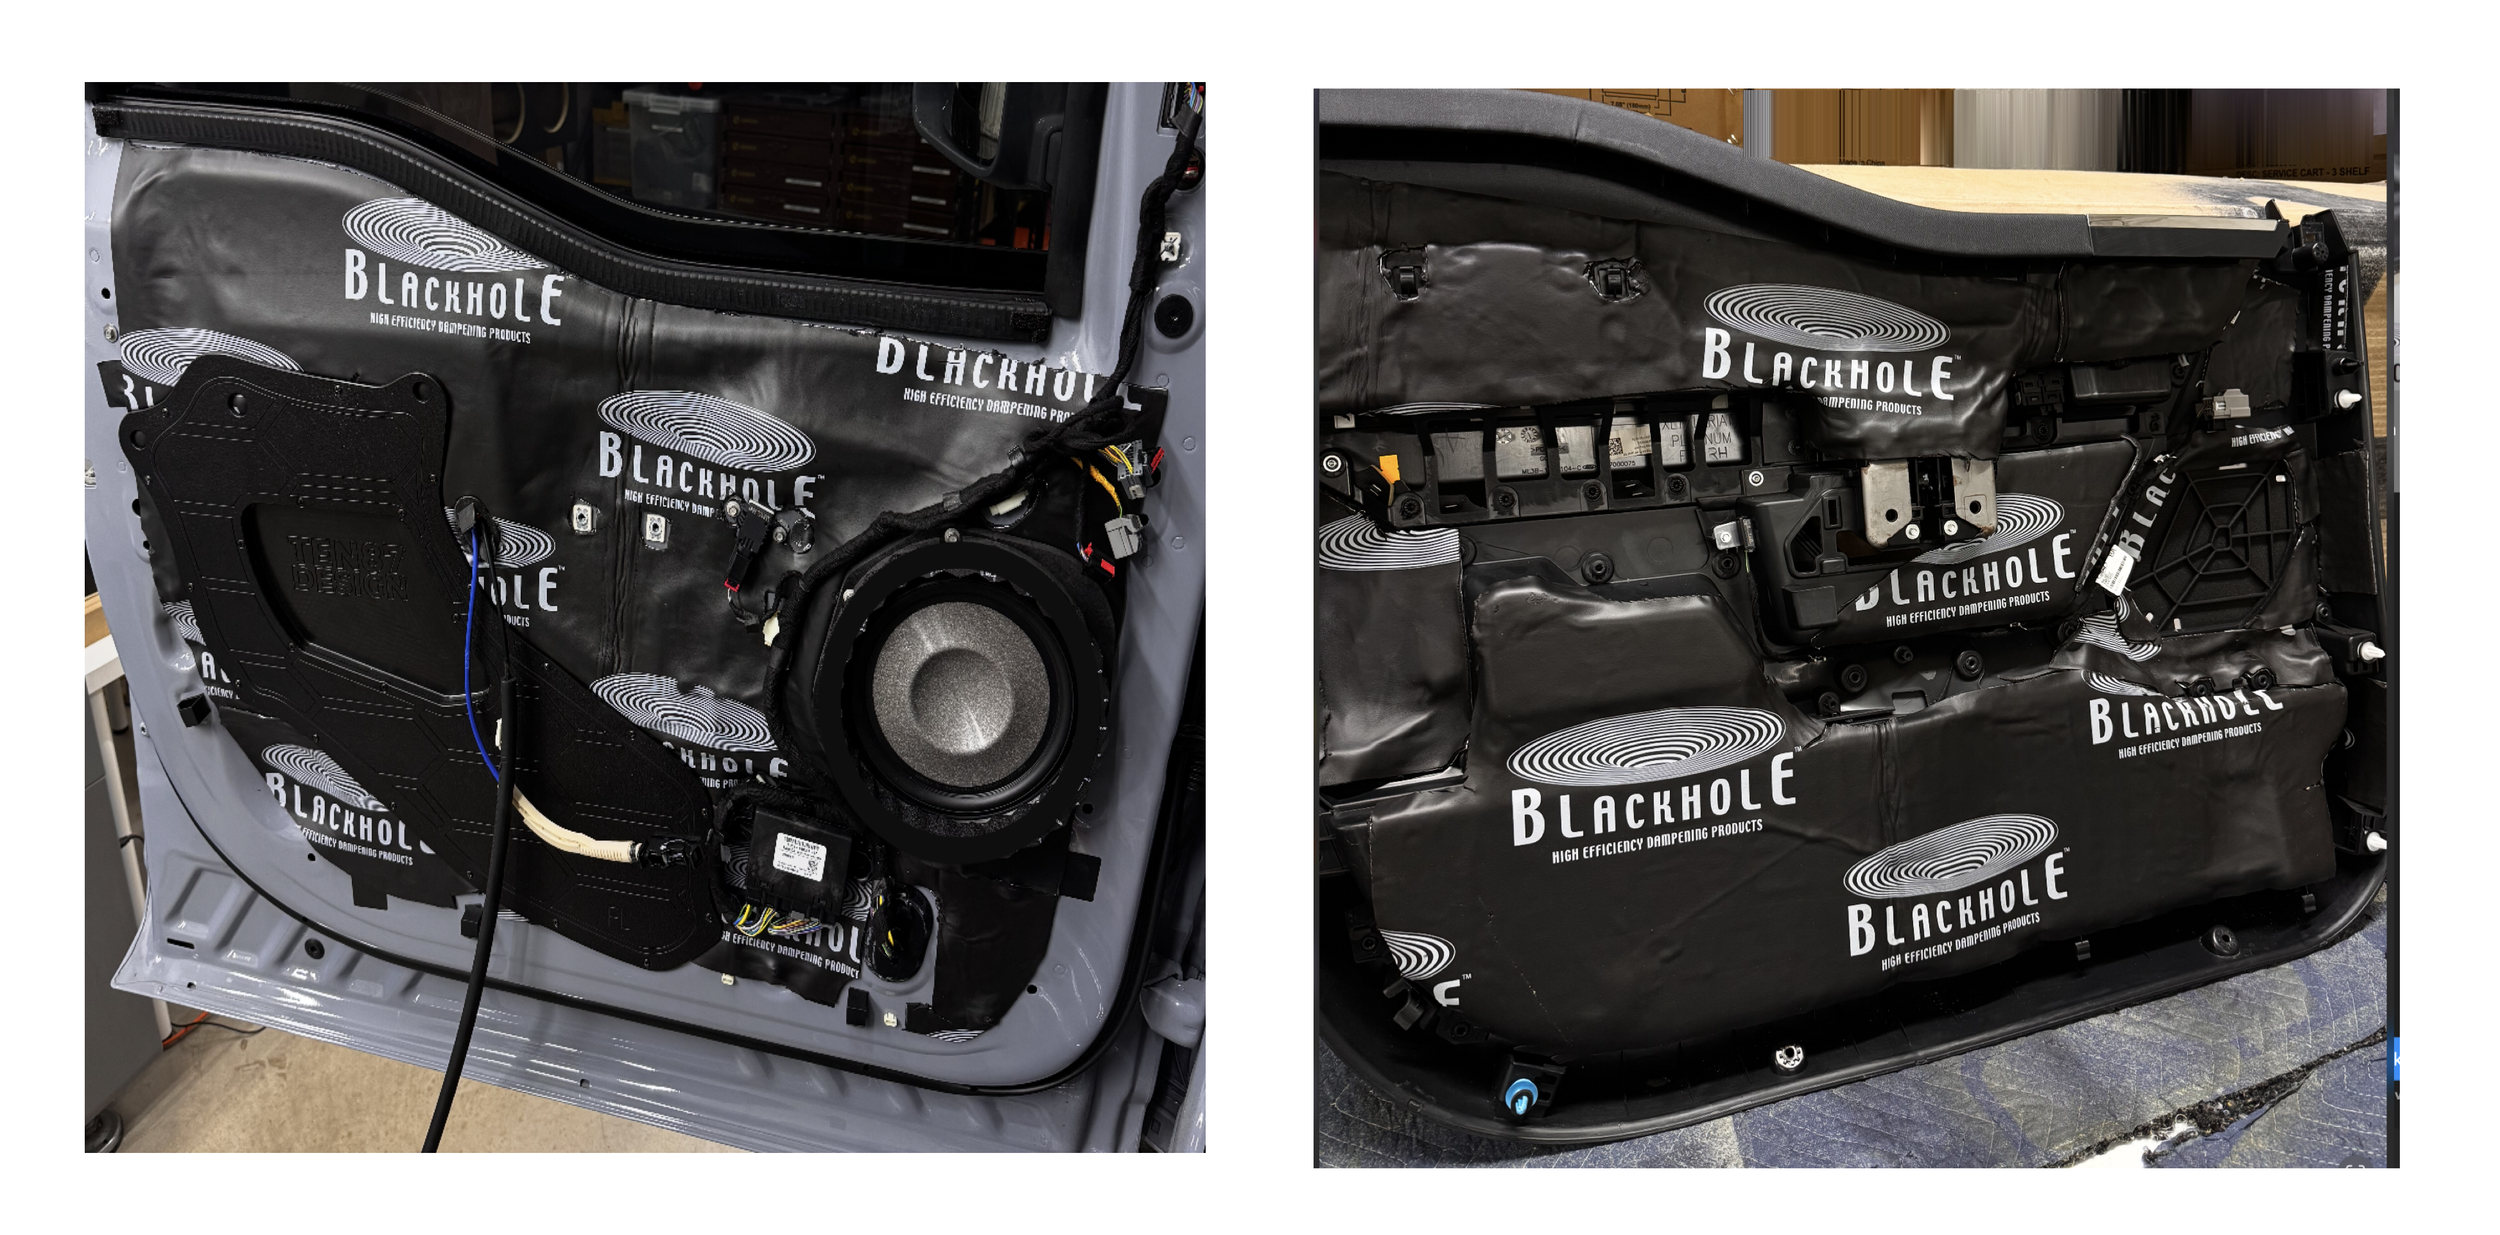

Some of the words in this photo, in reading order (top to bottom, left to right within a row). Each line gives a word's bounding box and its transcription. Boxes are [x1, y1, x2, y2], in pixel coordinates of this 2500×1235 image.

[2262, 169, 2298, 178] SERVICE
[2300, 168, 2324, 177] CART
[2332, 167, 2337, 176] 3
[2339, 167, 2371, 176] SHELF
[345, 249, 565, 326] BLACKHOLE
[370, 312, 389, 325] HIGH
[391, 315, 437, 332] EFFICIENCY
[438, 321, 487, 338] DAMPENING
[489, 328, 531, 344] PRODUCTS
[2323, 295, 2333, 341] DAMPENING
[1702, 327, 1954, 401] BLACKHOLE
[903, 388, 927, 403] HIGH
[929, 392, 984, 412] EFFICIENCY
[986, 399, 1047, 420] DAMPENING
[1876, 401, 1922, 416] PRODUCTS
[2231, 435, 2248, 448] HIGH
[2248, 429, 2282, 445] EFFICIENCY
[624, 488, 643, 504] HIGH
[646, 493, 690, 514] EFFICIENCY
[287, 535, 406, 575] TEN87
[292, 564, 409, 602] DESIGN
[1886, 614, 1907, 628] HIGH
[1910, 606, 1957, 624] EFFICIENCY
[1959, 598, 2007, 617] DAMPENING
[2009, 590, 2050, 608] PRODUCTS
[2118, 746, 2137, 760] HIGH
[2138, 739, 2180, 755] EFFICIENCY
[2182, 730, 2223, 747] DAMPENING
[2224, 722, 2262, 739] PRODUCTS
[1511, 751, 1797, 847] BLACKHOLE
[338, 840, 377, 858] DAMPENING
[378, 850, 414, 866] PRODUCTS
[1552, 847, 1579, 864] HIGH
[1582, 837, 1644, 860] EFFICIENCY
[1647, 827, 1709, 850] DAMPENING
[1711, 818, 1763, 839] PRODUCTS
[1847, 851, 2068, 957] BLACKHOLE
[732, 933, 776, 952] EFFICIENCY
[777, 945, 822, 967] DAMPENING
[1881, 954, 1902, 972] HIGH
[1904, 941, 1952, 964] EFFICIENCY
[1955, 925, 2001, 951] DAMPENING
[2003, 912, 2041, 934] PRODUCTS
